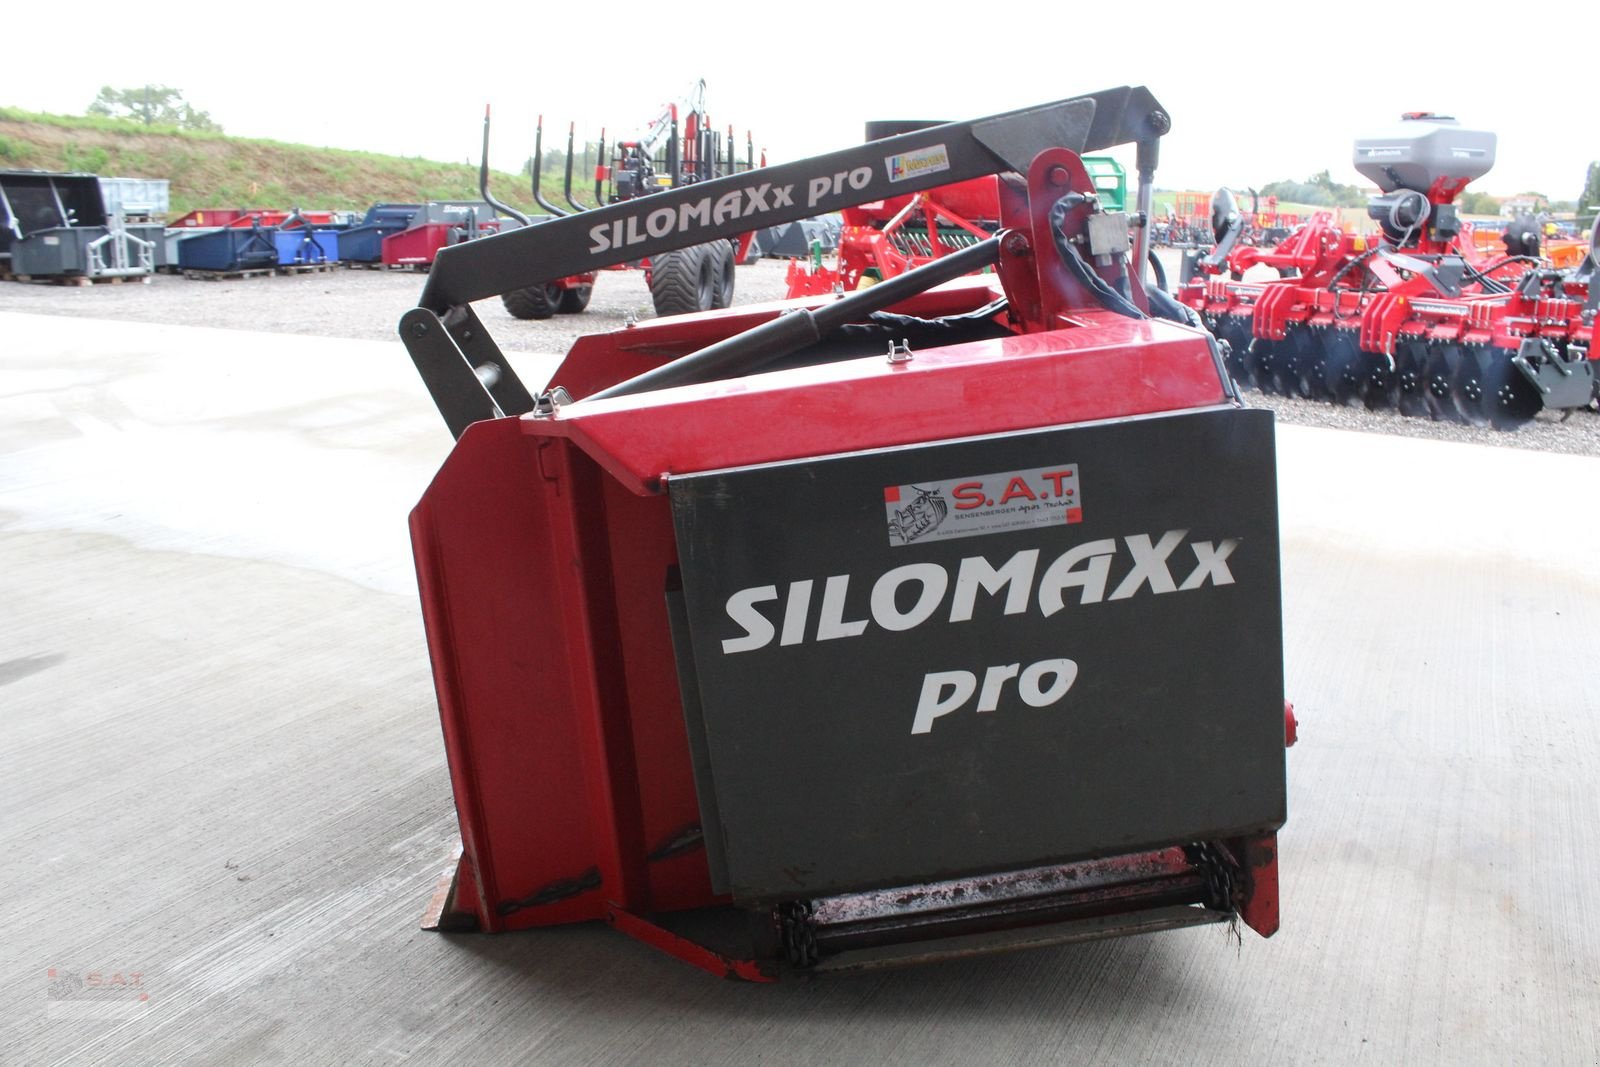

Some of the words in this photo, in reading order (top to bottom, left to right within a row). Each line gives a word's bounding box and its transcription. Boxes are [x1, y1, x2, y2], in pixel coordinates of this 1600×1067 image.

[808, 166, 873, 207] pro
[951, 470, 1075, 511] S.A.T.
[911, 657, 1078, 735] pro
